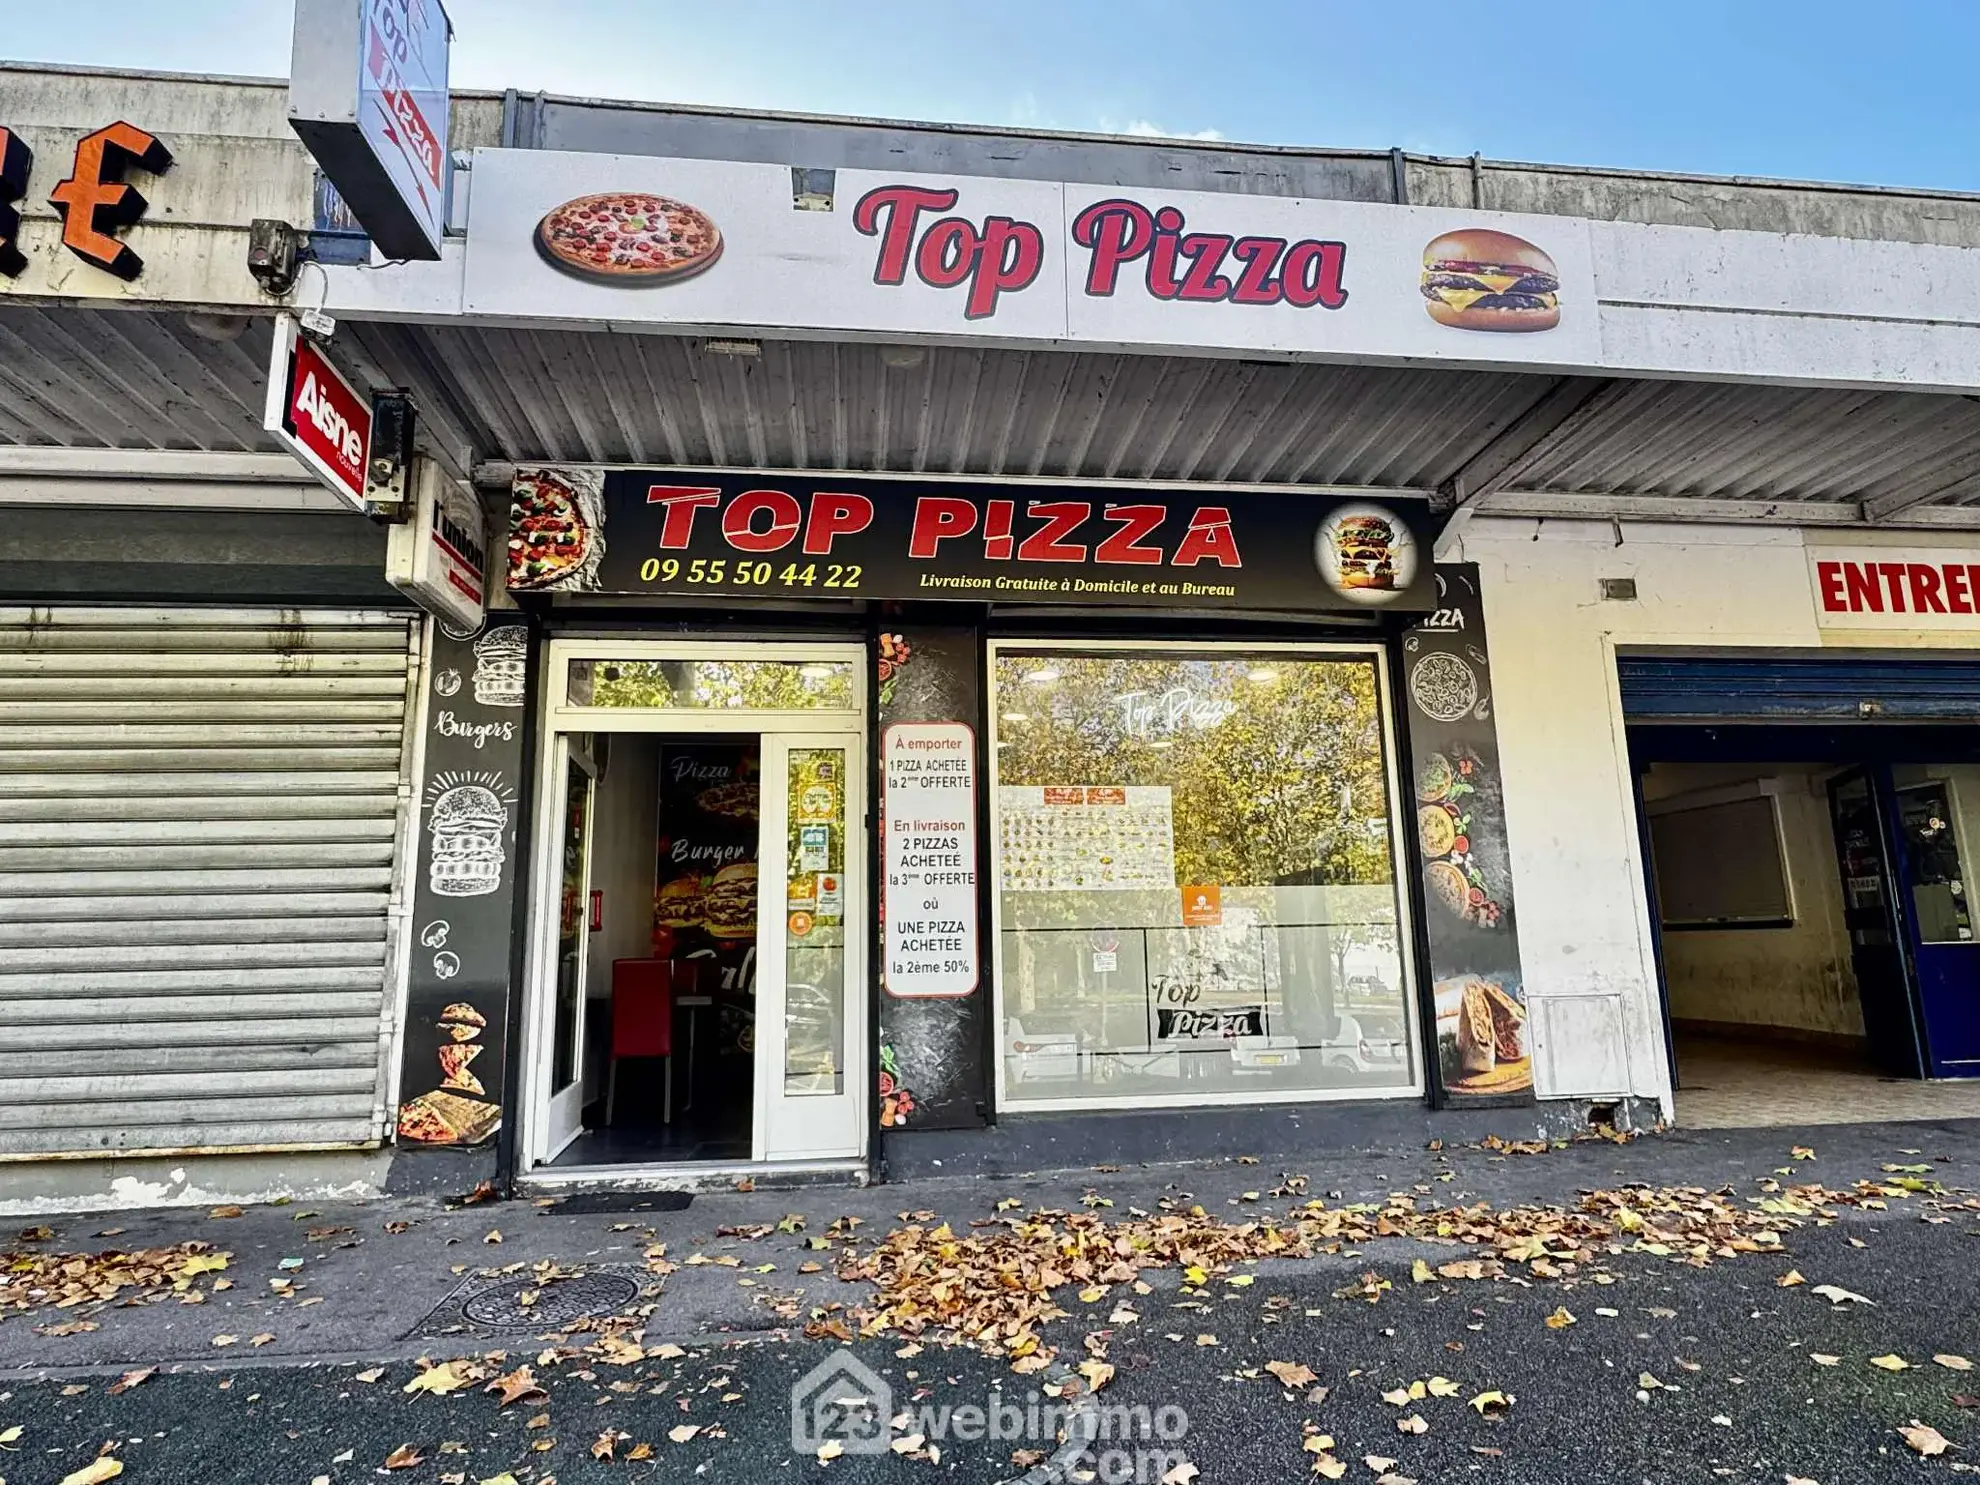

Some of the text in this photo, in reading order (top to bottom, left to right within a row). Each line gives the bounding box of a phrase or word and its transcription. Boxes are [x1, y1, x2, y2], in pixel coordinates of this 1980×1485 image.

[379, 52, 436, 182] Pizza
[0, 120, 172, 280] E
[852, 184, 1349, 320] Top Pizza
[296, 371, 363, 466] Aisne
[647, 486, 1242, 567] TOP PIZZA
[640, 558, 862, 588] 09 55 50 44 22
[920, 574, 1235, 596] Livraison Gratuite à Domicile et au Bureau
[1816, 562, 1980, 613] ENTRE
[433, 710, 518, 749] Burgers
[896, 734, 962, 751] À emporter
[671, 756, 731, 782] Pizza
[890, 760, 894, 771] 1
[897, 760, 922, 771] PIZZA
[889, 776, 898, 788] la
[920, 776, 971, 788] OFFERTE
[894, 820, 965, 832] En livraison
[671, 839, 744, 868] Burger
[903, 838, 958, 850] 2 PIZZAS
[889, 873, 899, 885] la
[924, 872, 975, 885] OFFERTE
[923, 897, 939, 909] où
[898, 921, 965, 934] UNE PIZZA
[892, 962, 903, 973] la
[944, 960, 969, 972] 50%
[1152, 974, 1201, 1007] Top
[1166, 1010, 1253, 1038] Pizza
